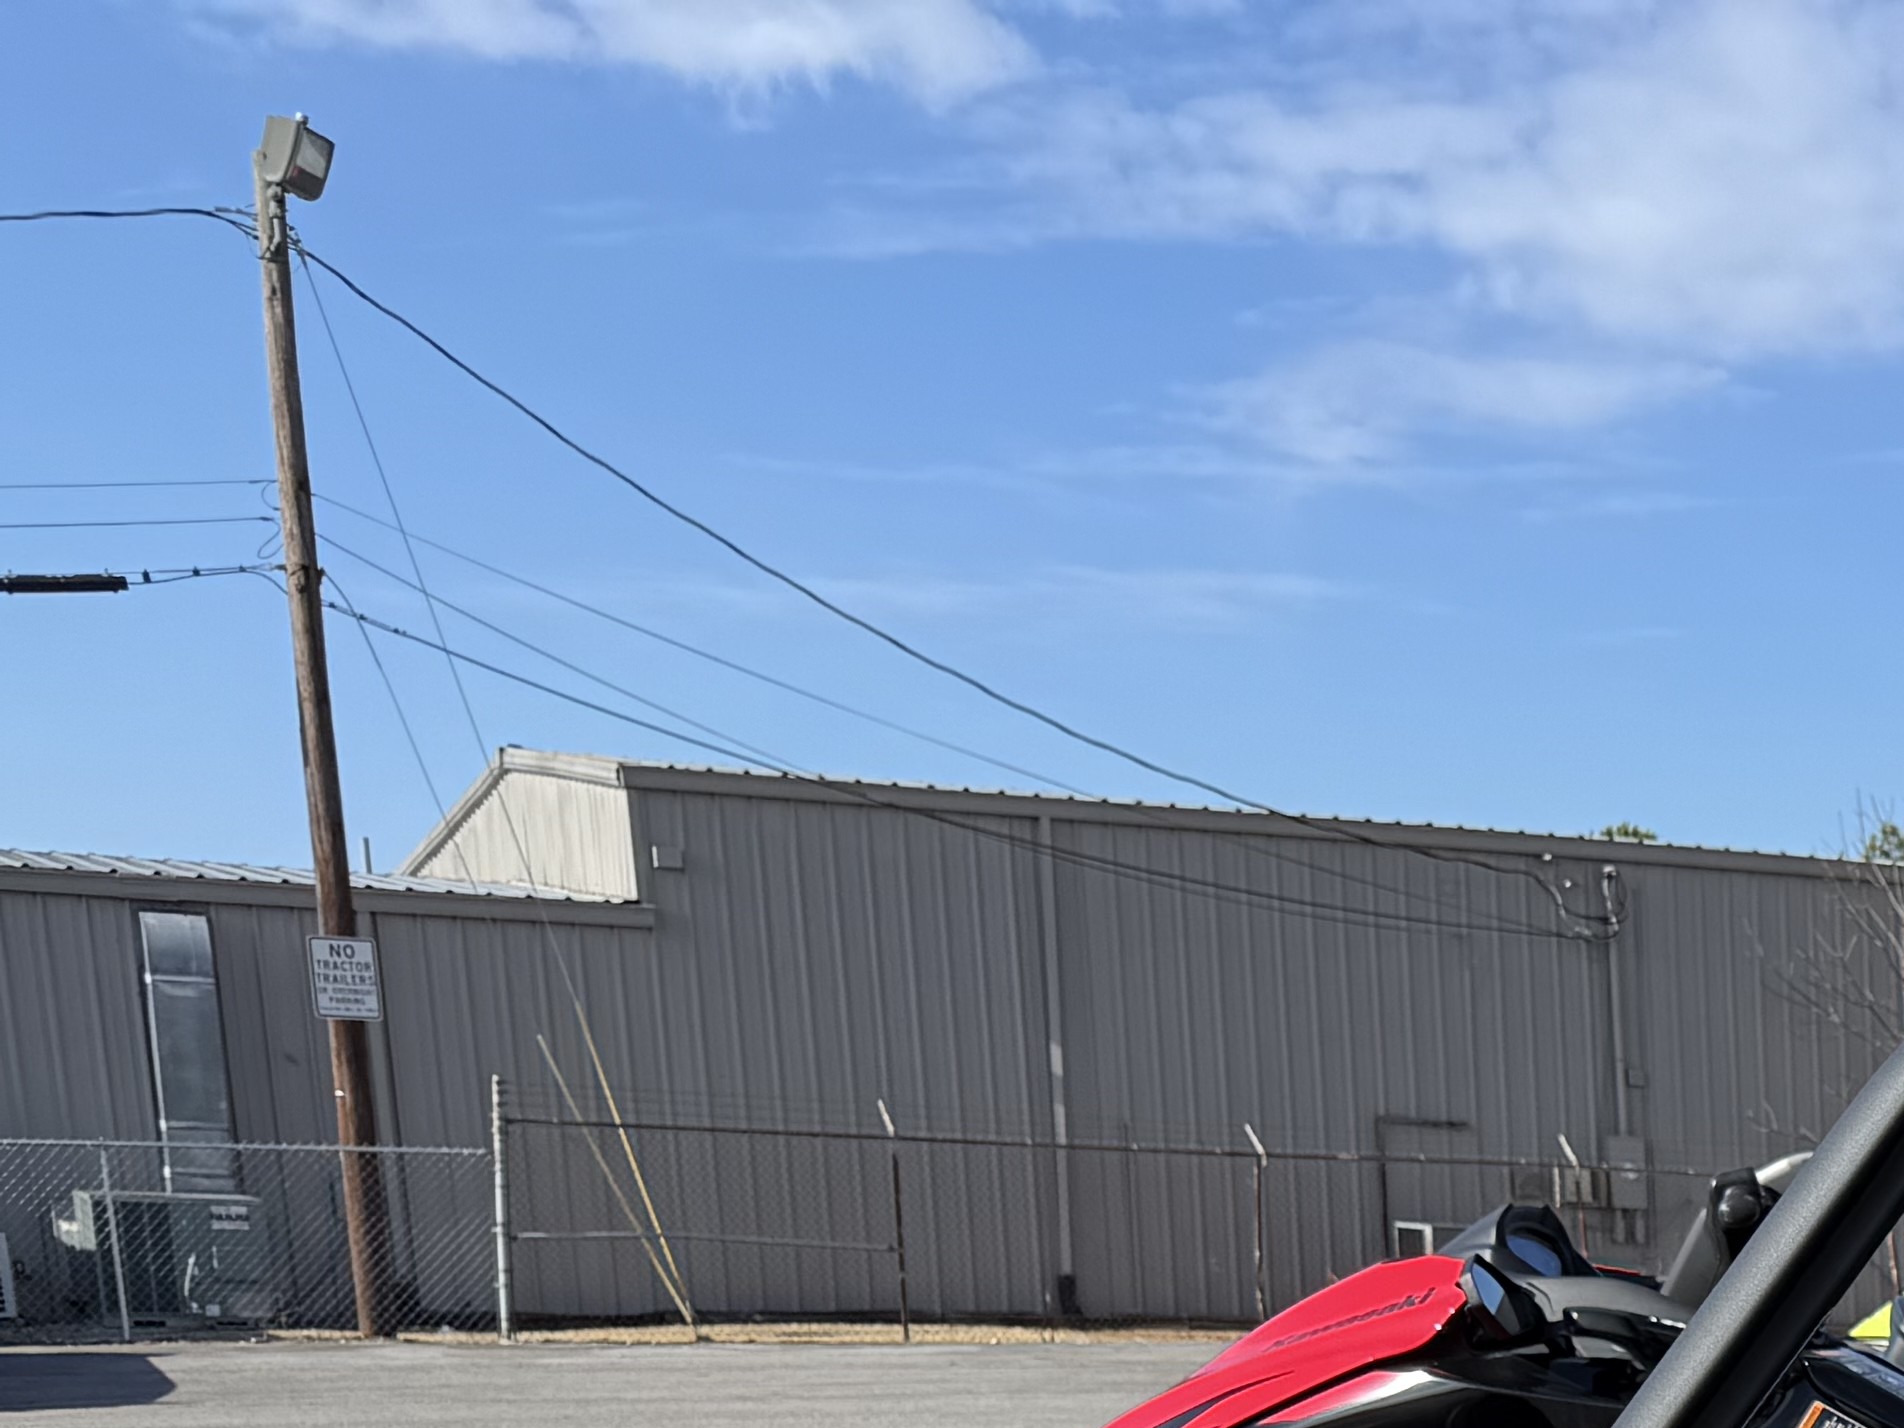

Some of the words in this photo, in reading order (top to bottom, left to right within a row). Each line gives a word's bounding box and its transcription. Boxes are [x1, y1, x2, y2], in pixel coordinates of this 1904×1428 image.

[328, 943, 355, 959] NO
[316, 959, 372, 973] TRACTOR
[316, 973, 375, 986] TRAILERS
